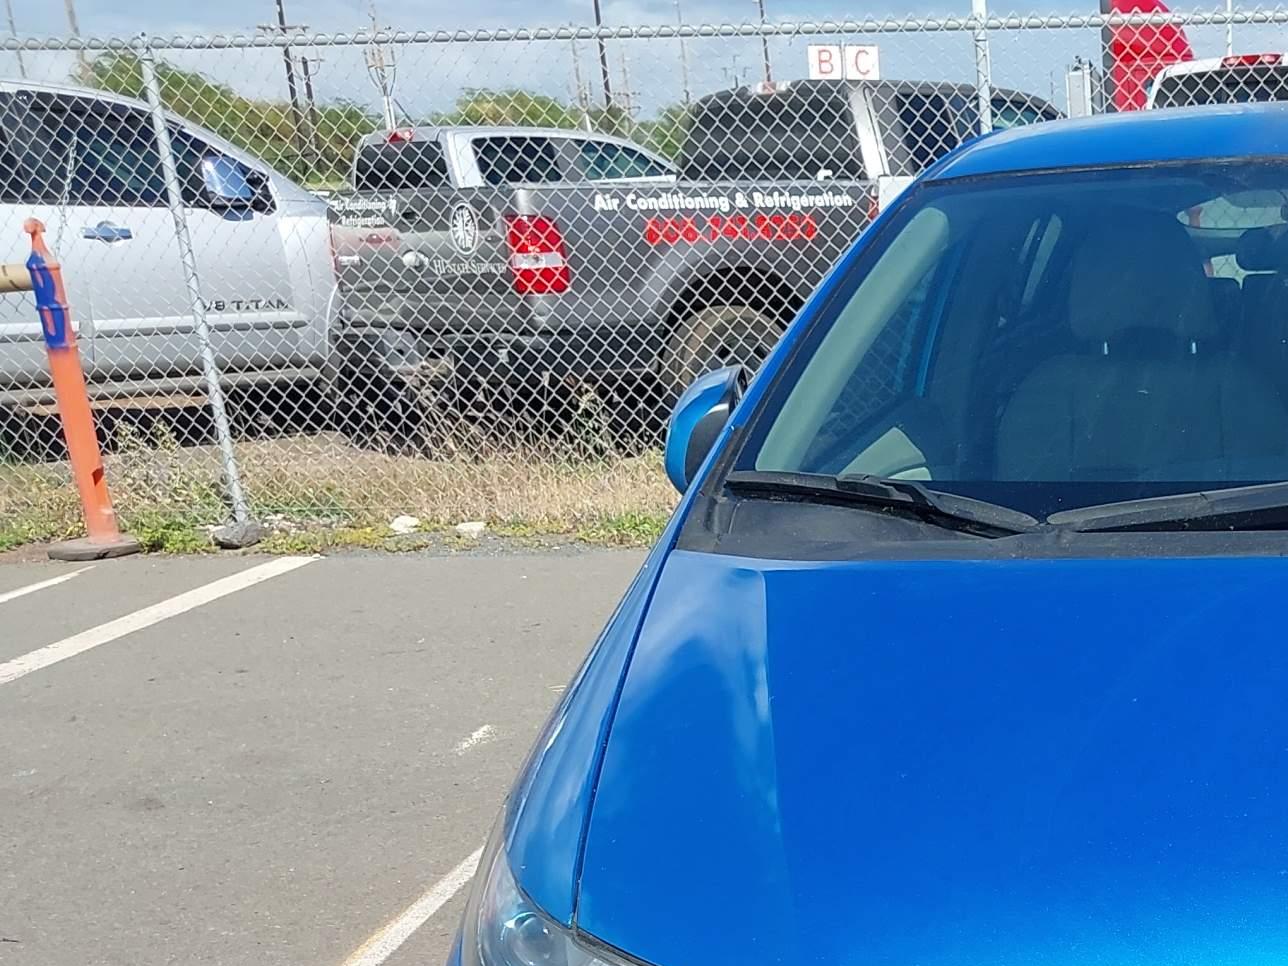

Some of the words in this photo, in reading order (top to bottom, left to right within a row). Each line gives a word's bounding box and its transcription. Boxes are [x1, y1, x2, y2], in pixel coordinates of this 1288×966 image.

[818, 49, 834, 74] B
[855, 49, 870, 75] C
[594, 193, 619, 210] Air
[626, 193, 730, 212] Conditioning
[735, 192, 748, 208] &
[753, 191, 853, 211] Refrigeration
